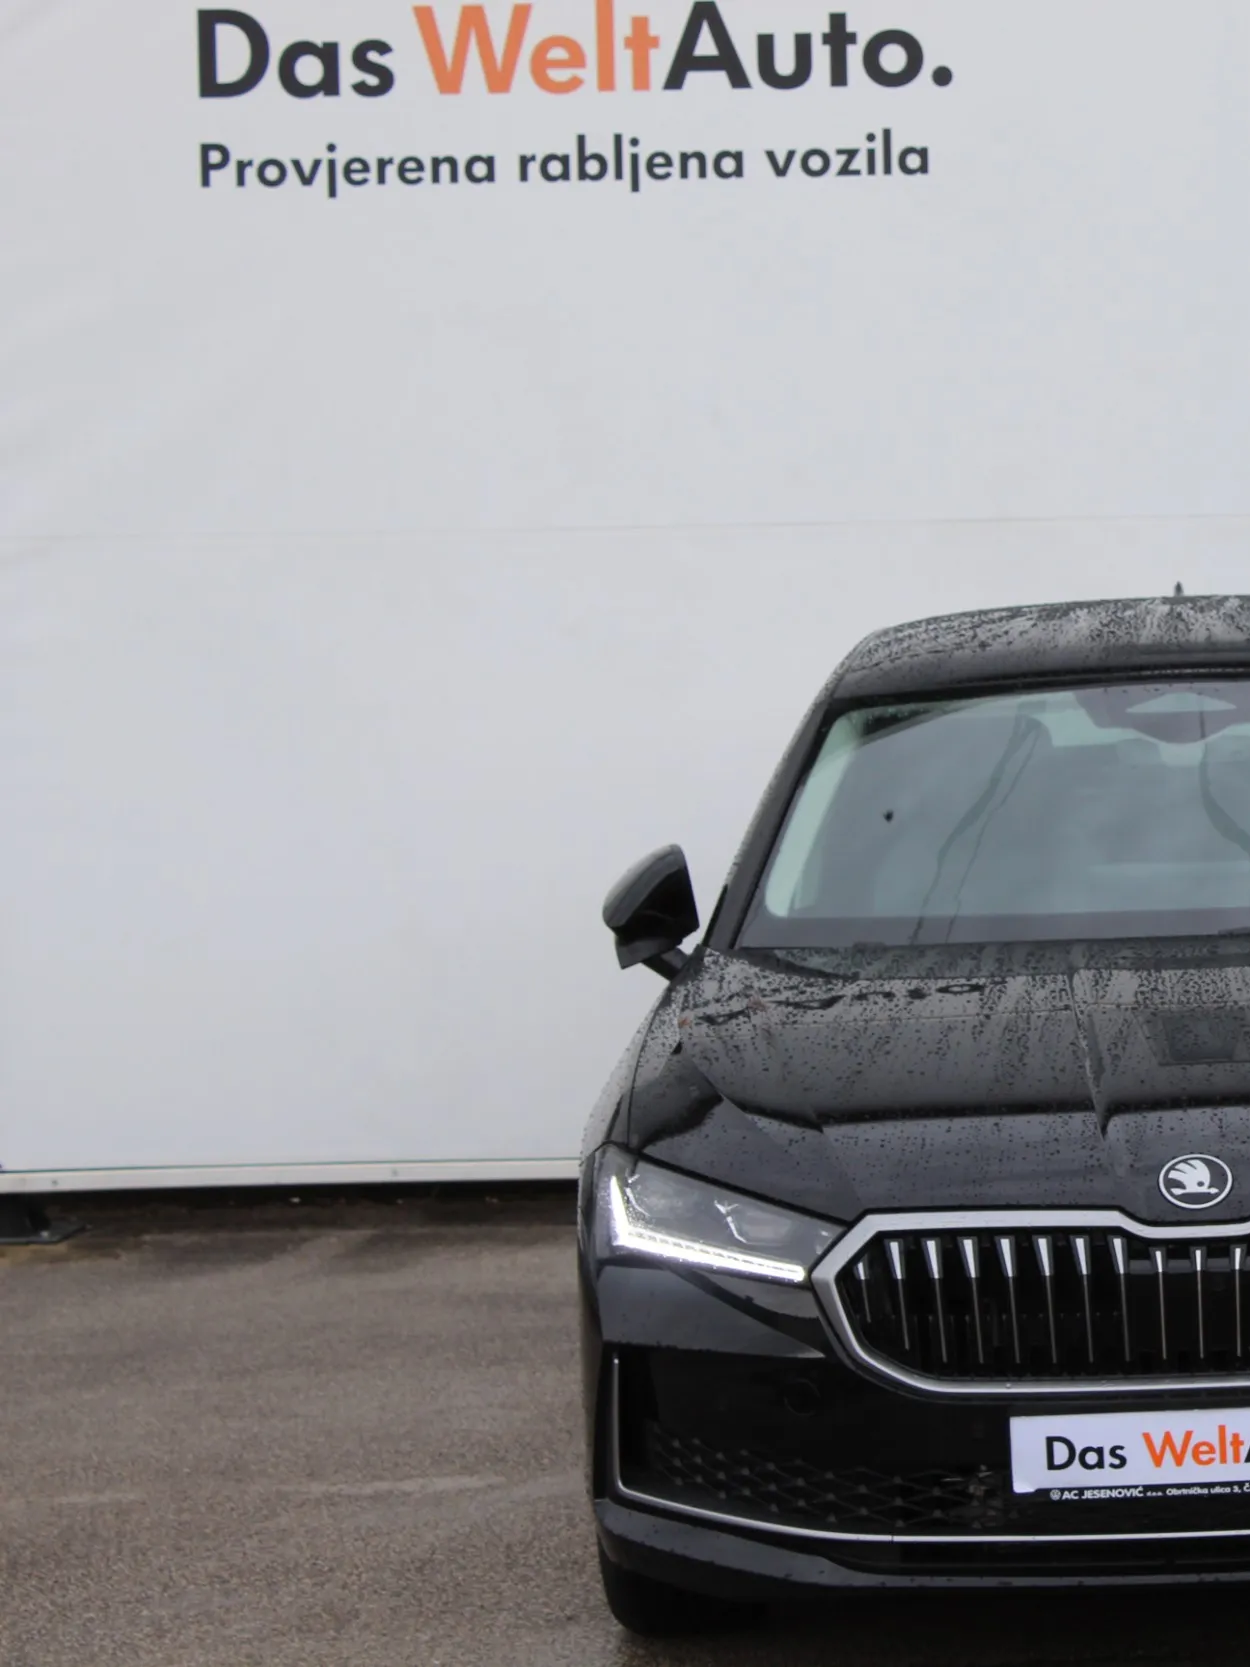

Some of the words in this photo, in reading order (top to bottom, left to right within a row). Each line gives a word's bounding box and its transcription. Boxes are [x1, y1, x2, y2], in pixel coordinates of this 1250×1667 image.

[197, 9, 395, 99] Das
[413, 0, 953, 95] WeltAuto.
[199, 142, 497, 199] Provjerena
[518, 132, 744, 193] rabljena
[764, 128, 929, 178] vozila
[1045, 1435, 1128, 1471] Das
[1062, 1489, 1079, 1500] AC
[1081, 1486, 1144, 1500] JESENOVIĆ
[1165, 1486, 1209, 1496] Obrtnička
[1210, 1484, 1231, 1494] ulica
